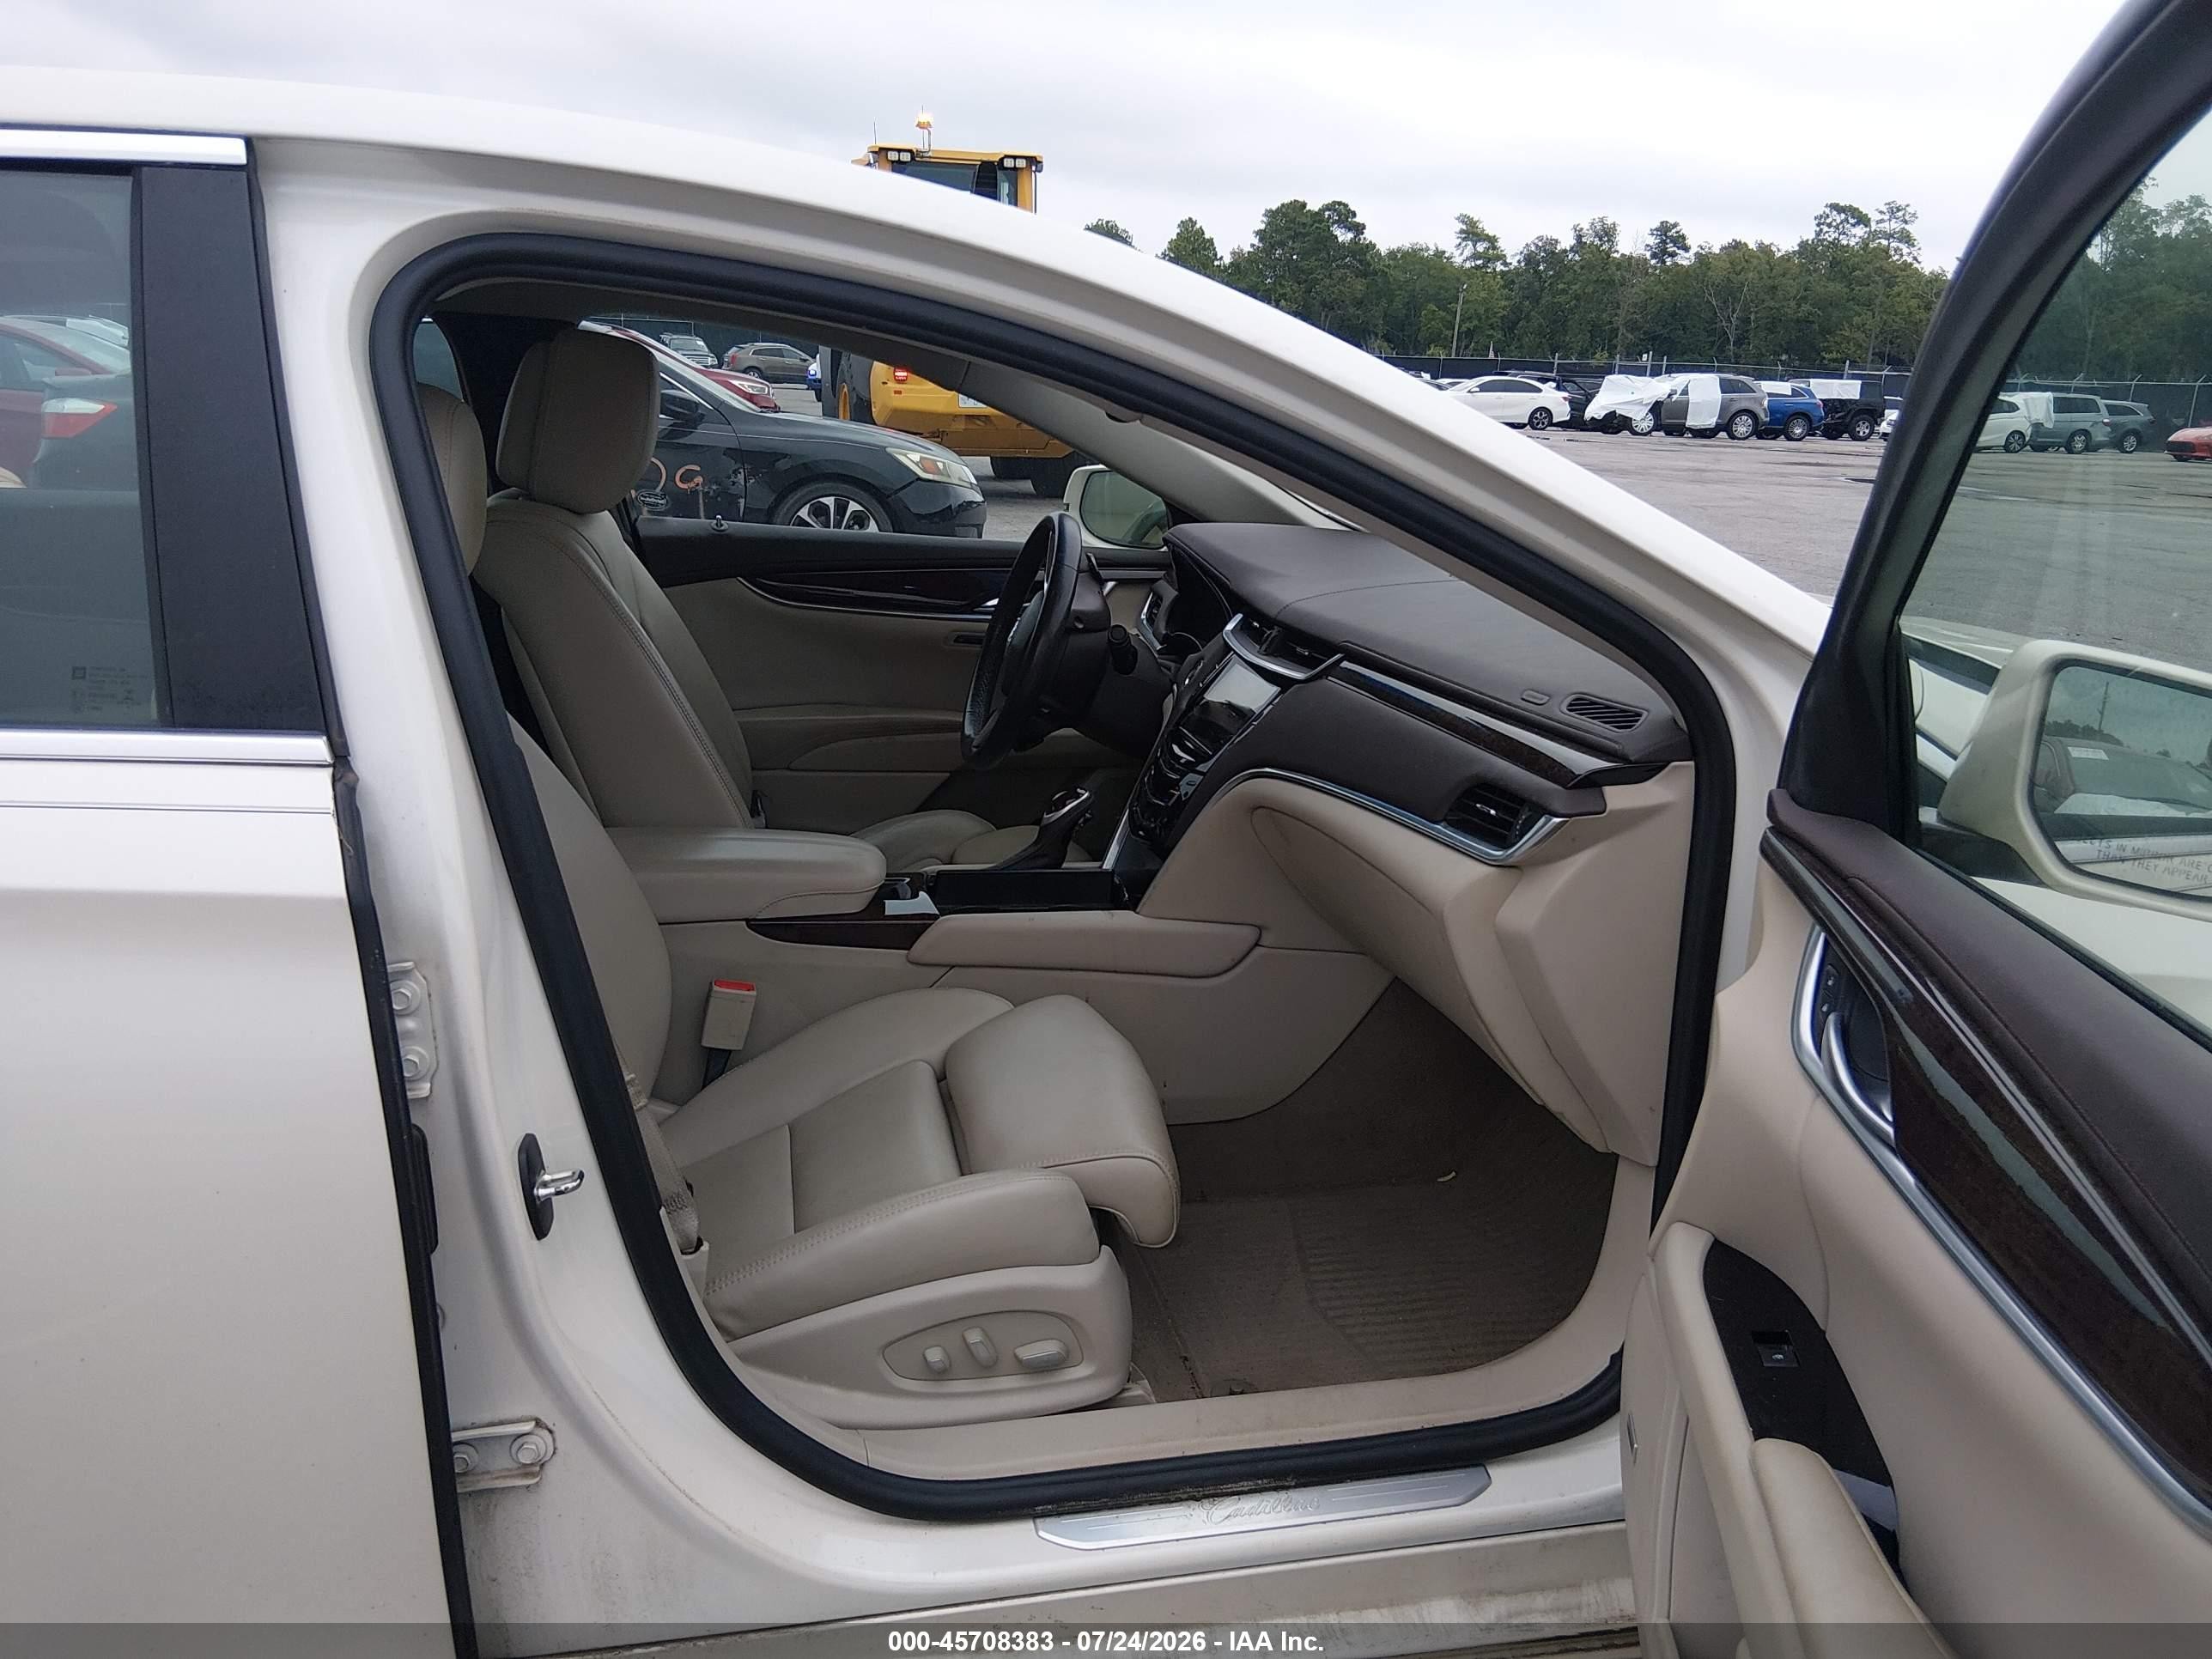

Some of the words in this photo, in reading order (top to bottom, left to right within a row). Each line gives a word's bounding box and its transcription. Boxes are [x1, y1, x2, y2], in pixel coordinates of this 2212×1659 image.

[2130, 859, 2159, 872] THEY
[2162, 864, 2209, 884] APPEAR
[2179, 857, 2204, 871] ARE
[1200, 1493, 1321, 1525] Cadillac
